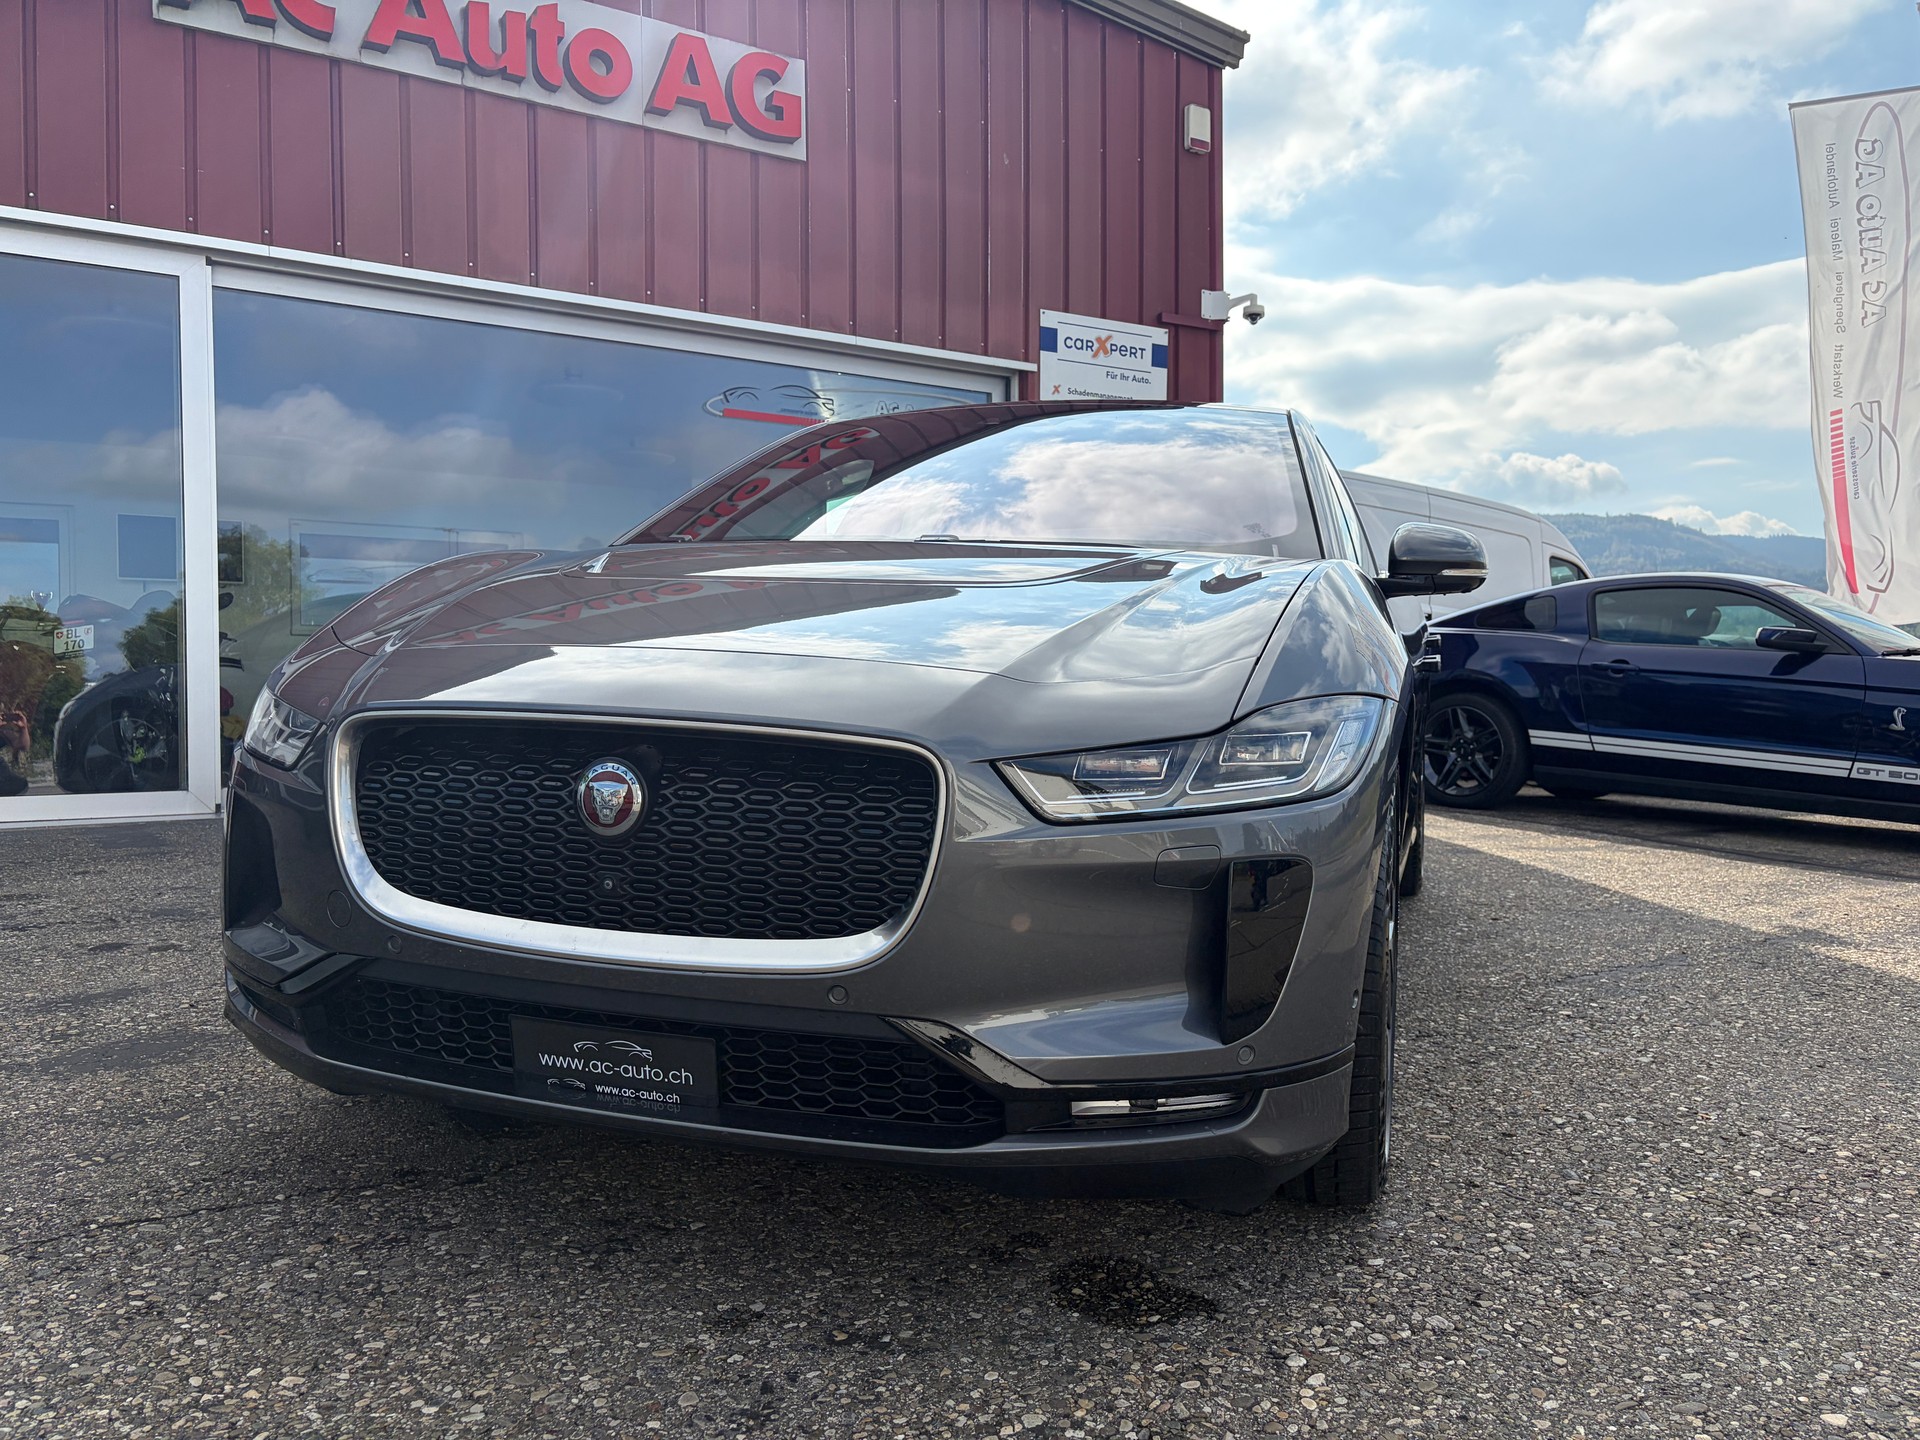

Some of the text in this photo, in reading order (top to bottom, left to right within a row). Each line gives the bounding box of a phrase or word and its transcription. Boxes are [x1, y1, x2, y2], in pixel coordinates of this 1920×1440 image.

[362, 0, 801, 143] Auto AG
[1105, 370, 1152, 385] Für Ihr Auto.
[66, 628, 81, 640] BL
[63, 638, 85, 651] 170
[1856, 767, 1920, 781] GT 50
[538, 1052, 694, 1086] www.ac-auto.ch
[594, 1084, 681, 1104] www.ac-auto.ch
